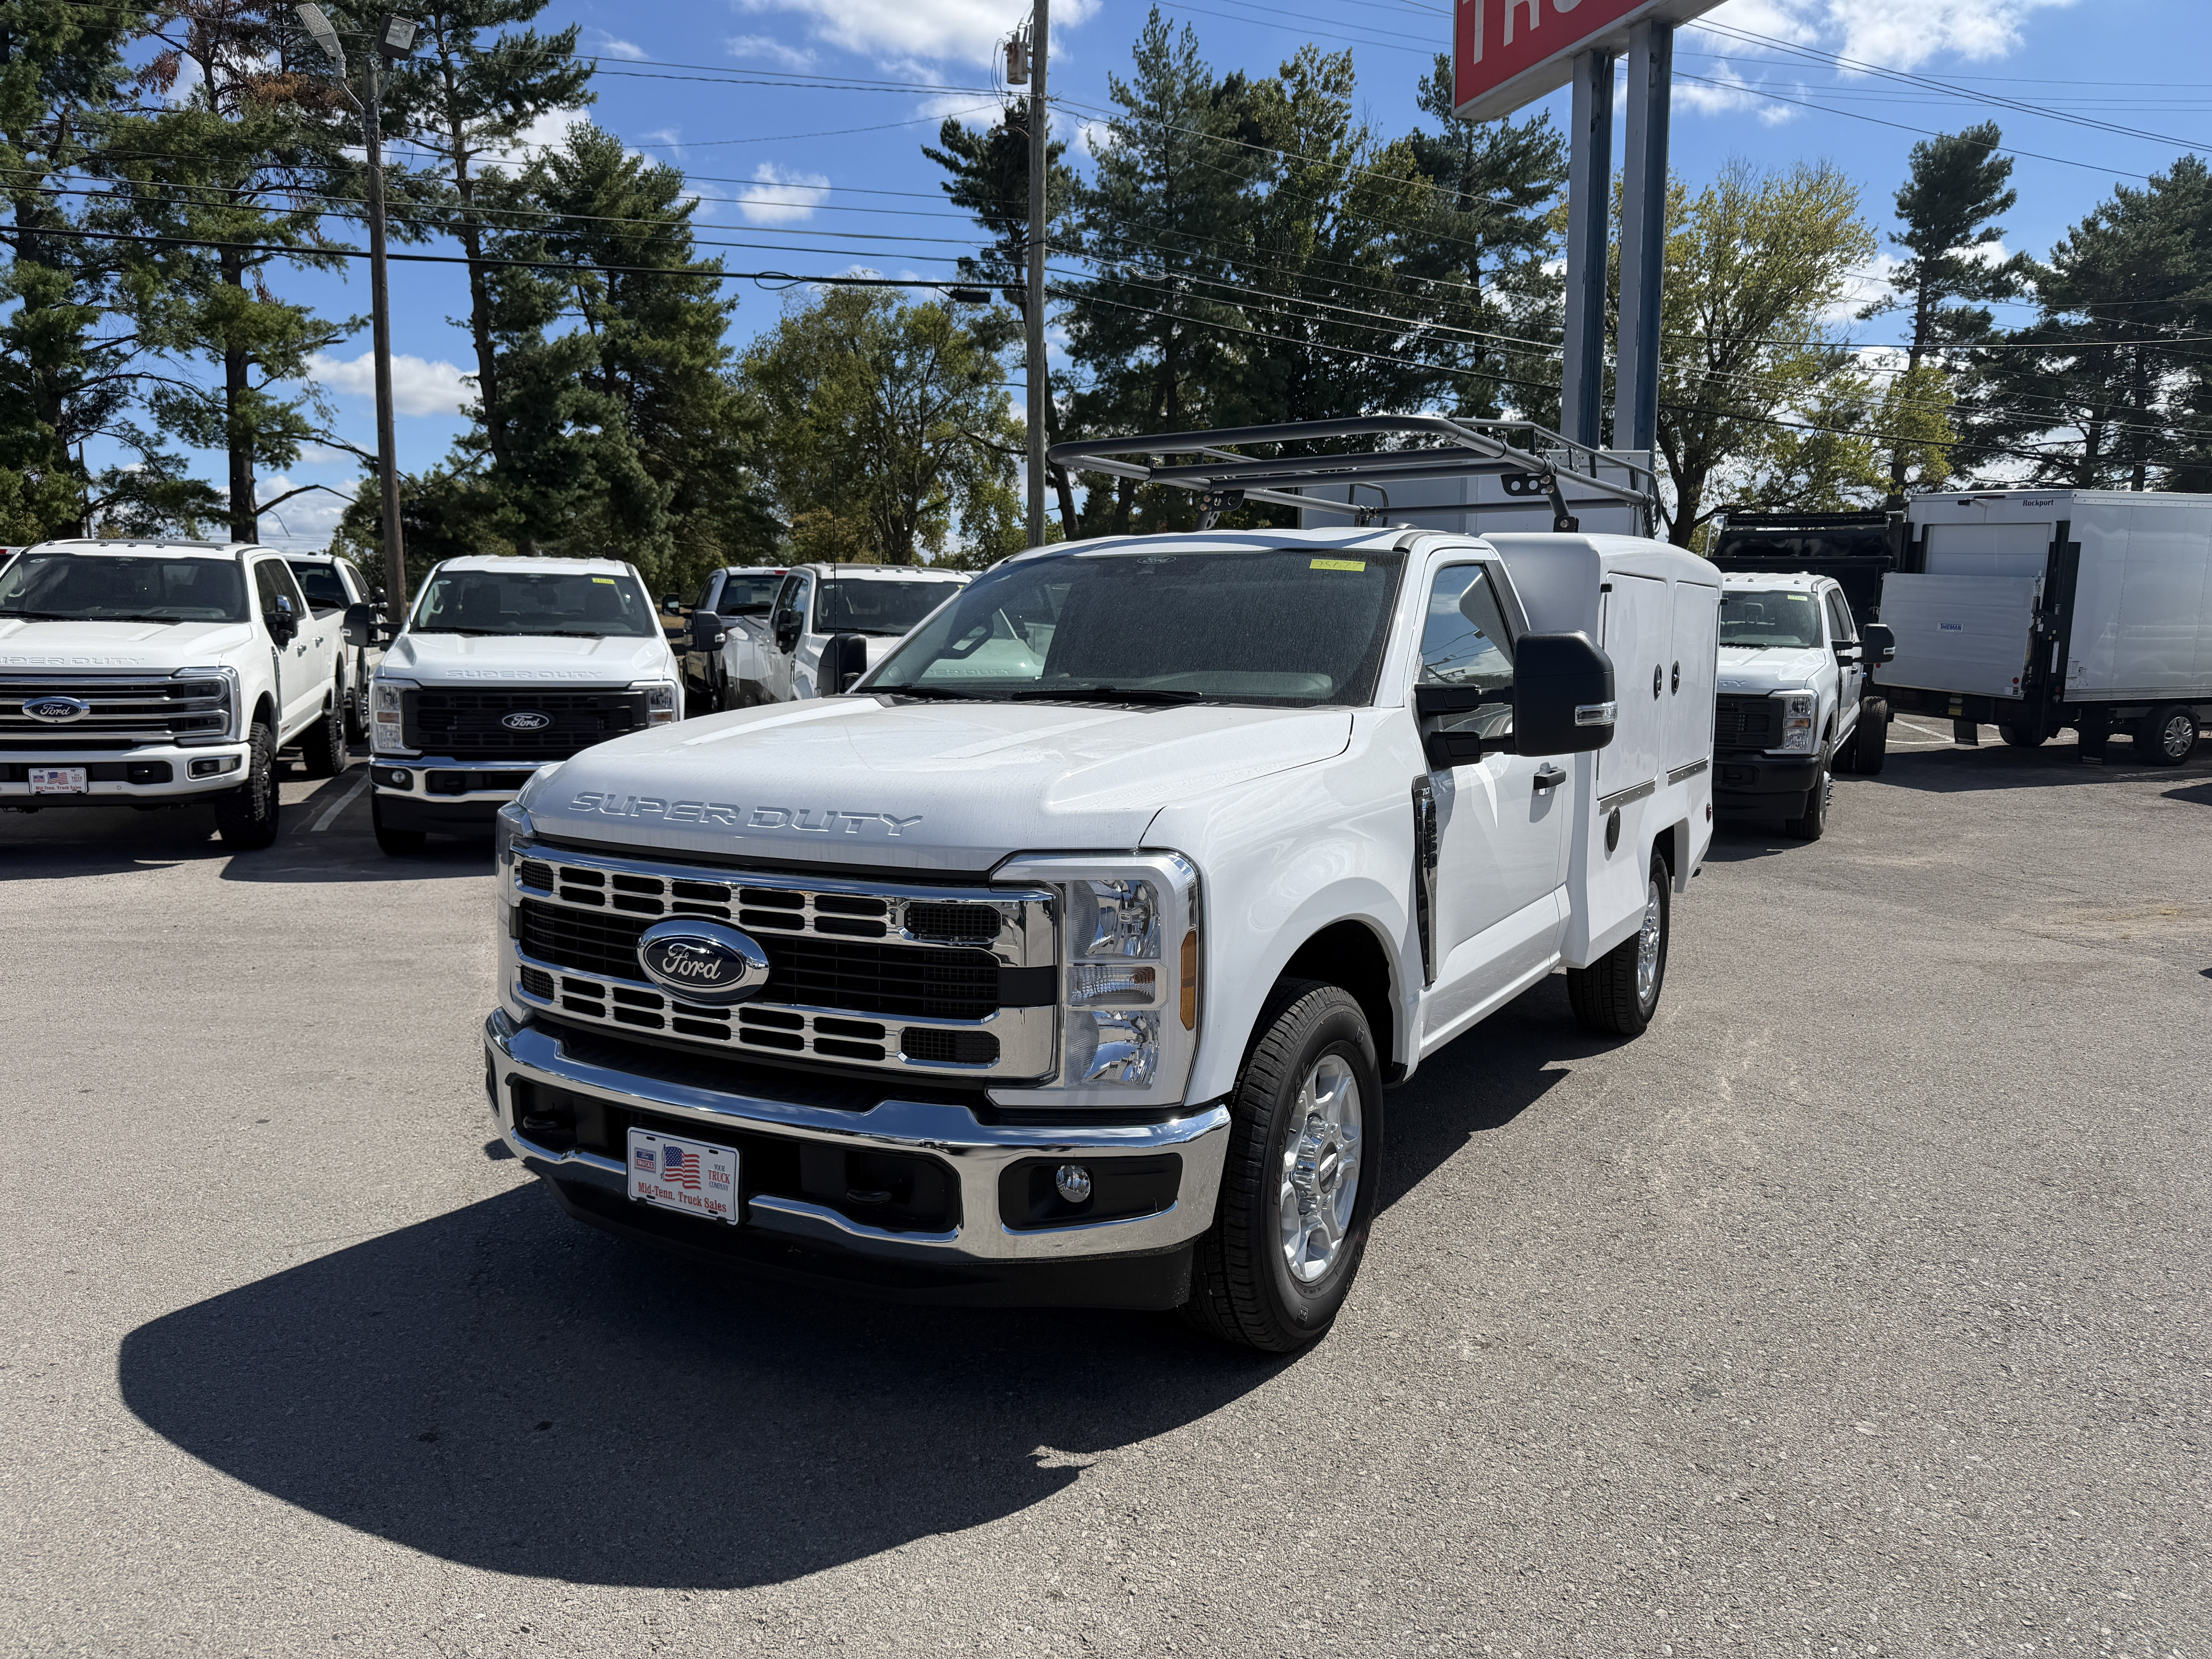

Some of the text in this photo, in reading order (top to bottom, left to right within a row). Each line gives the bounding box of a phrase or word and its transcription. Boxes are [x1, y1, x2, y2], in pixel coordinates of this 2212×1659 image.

[446, 670, 601, 679] SUPER DUTY
[40, 704, 70, 715] Ford
[511, 715, 540, 727] Ford
[568, 791, 923, 836] SUPER DUTY
[662, 943, 722, 981] Ford
[637, 1159, 654, 1168] TRUCKS
[714, 1163, 725, 1171] YOUR
[708, 1170, 730, 1184] TRUCK
[709, 1181, 729, 1191] COMPANY
[638, 1182, 727, 1212] Mid-Tenn. Truck Sales
